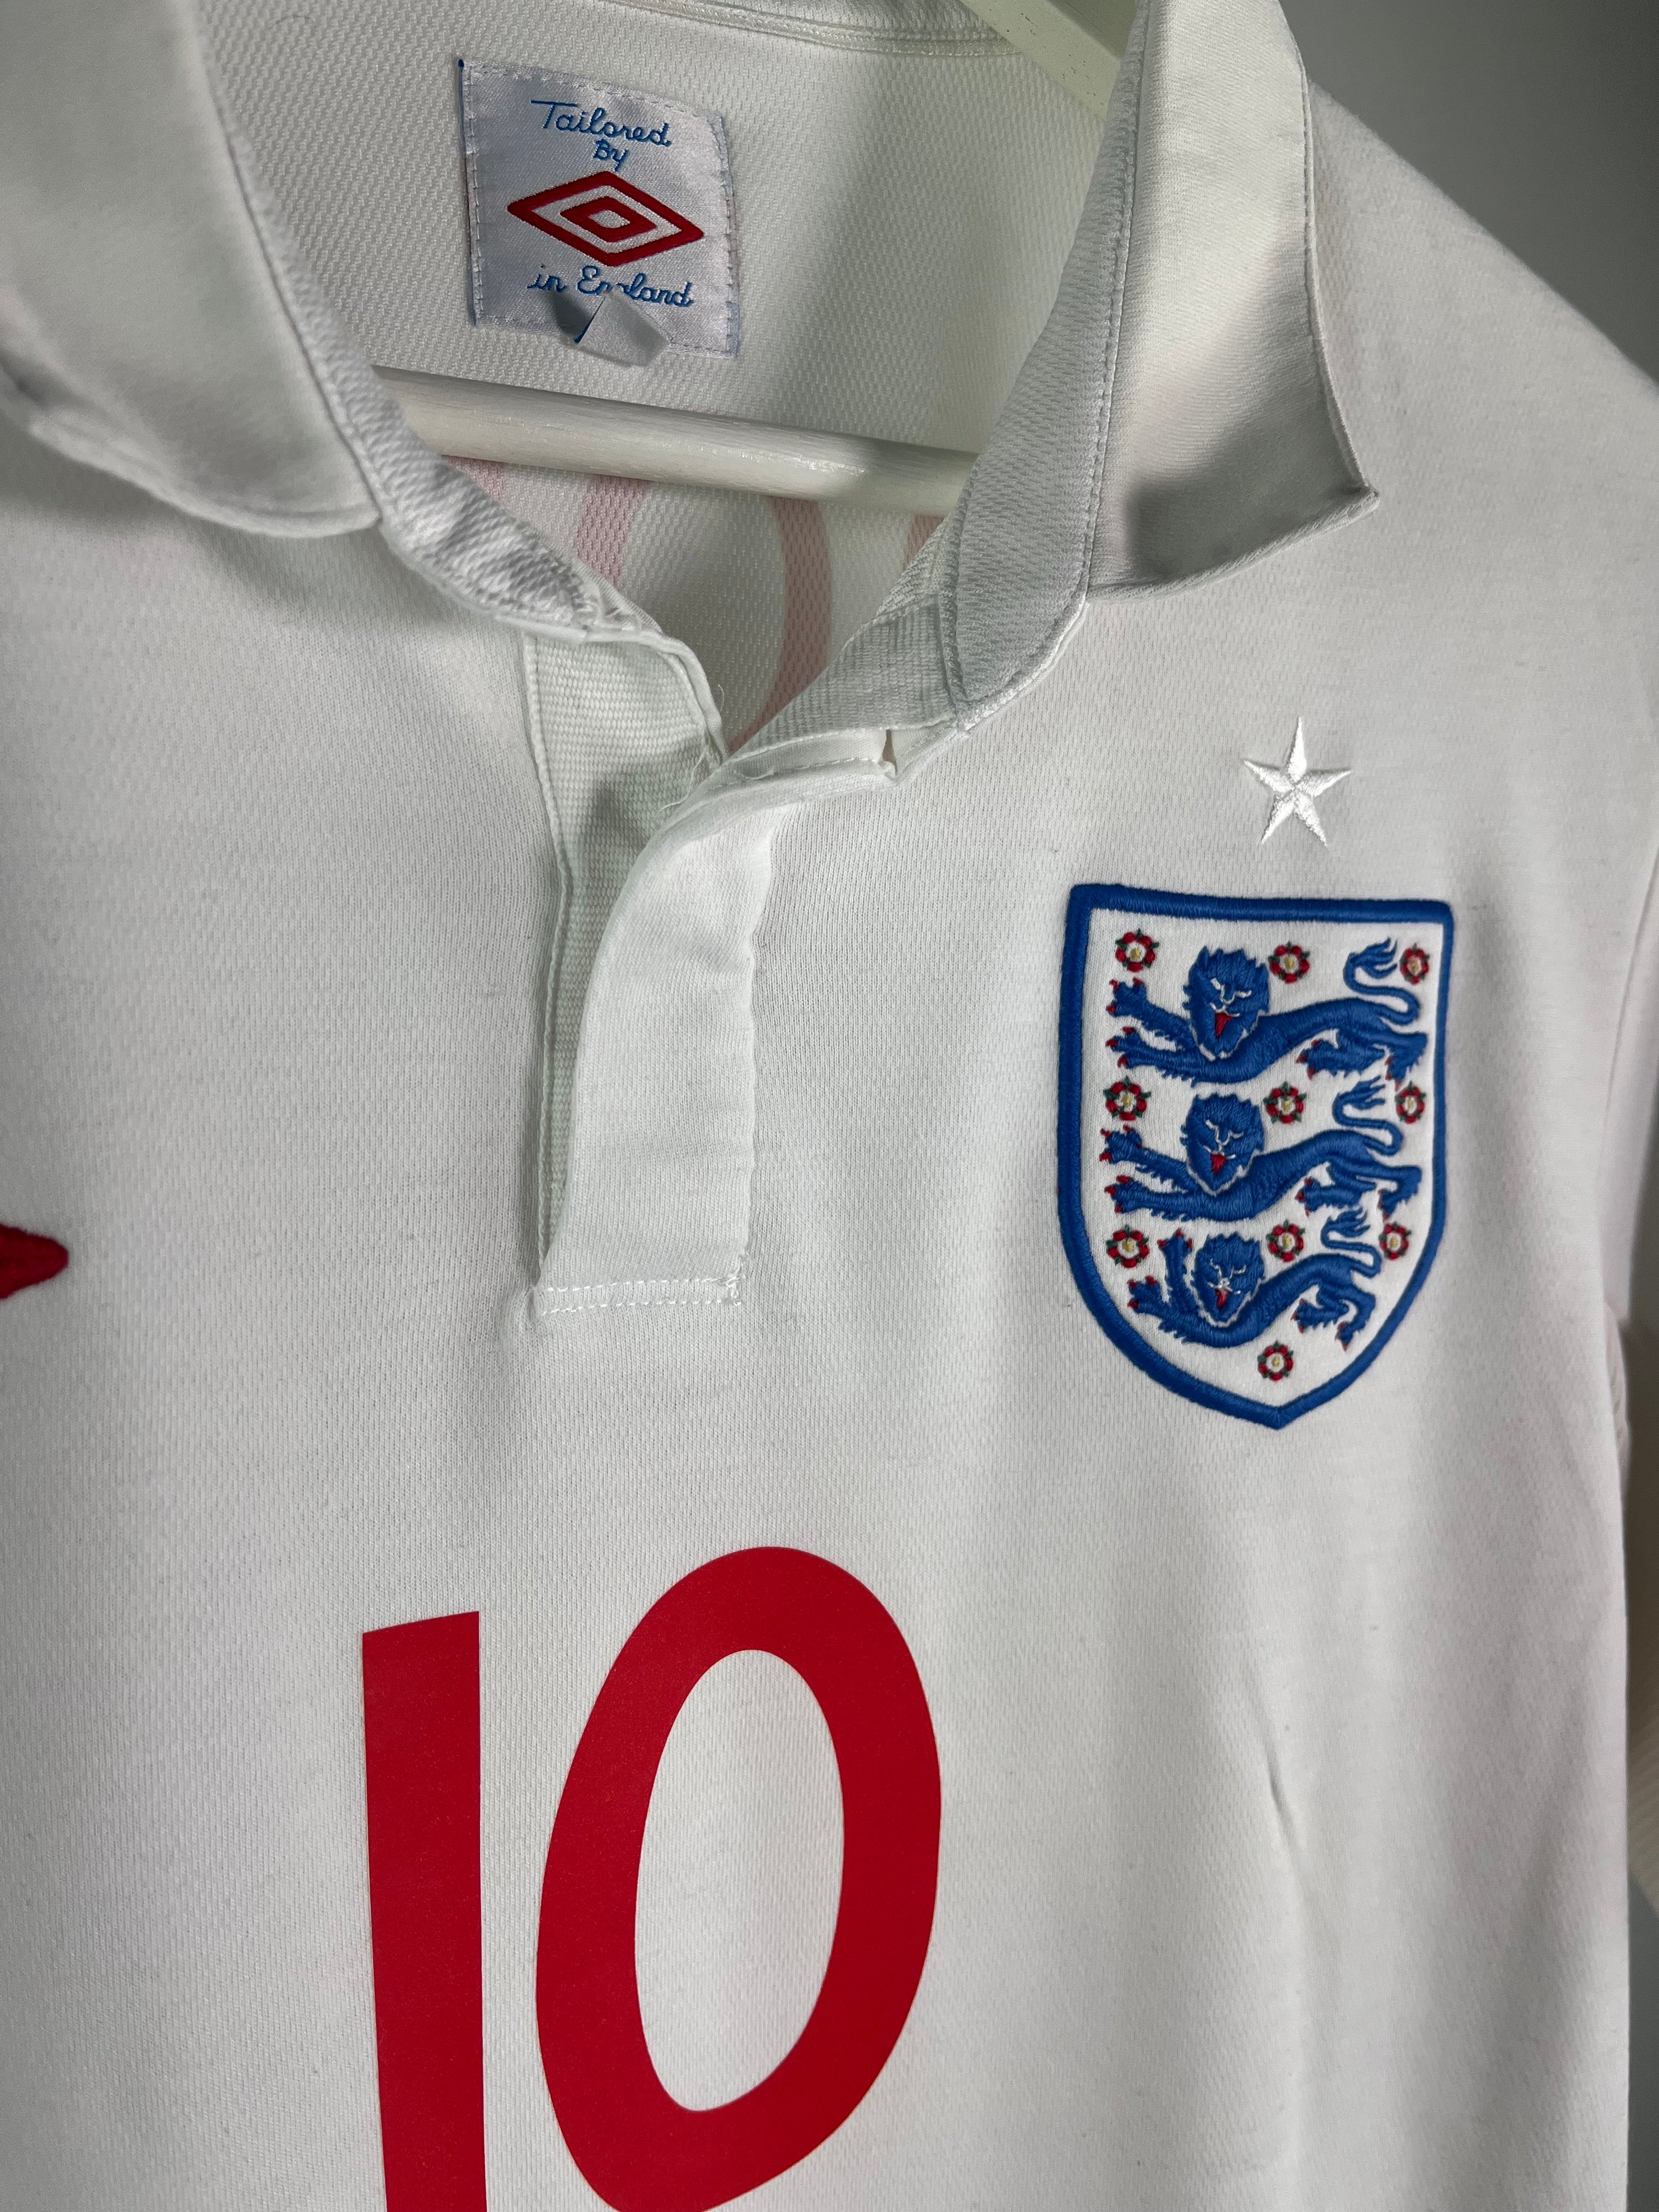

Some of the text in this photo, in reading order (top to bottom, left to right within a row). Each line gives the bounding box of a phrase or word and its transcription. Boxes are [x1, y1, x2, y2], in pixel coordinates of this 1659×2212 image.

[531, 99, 672, 147] Tailored
[593, 138, 629, 172] By
[527, 263, 693, 308] in Enland
[362, 1545, 941, 2212] 10
